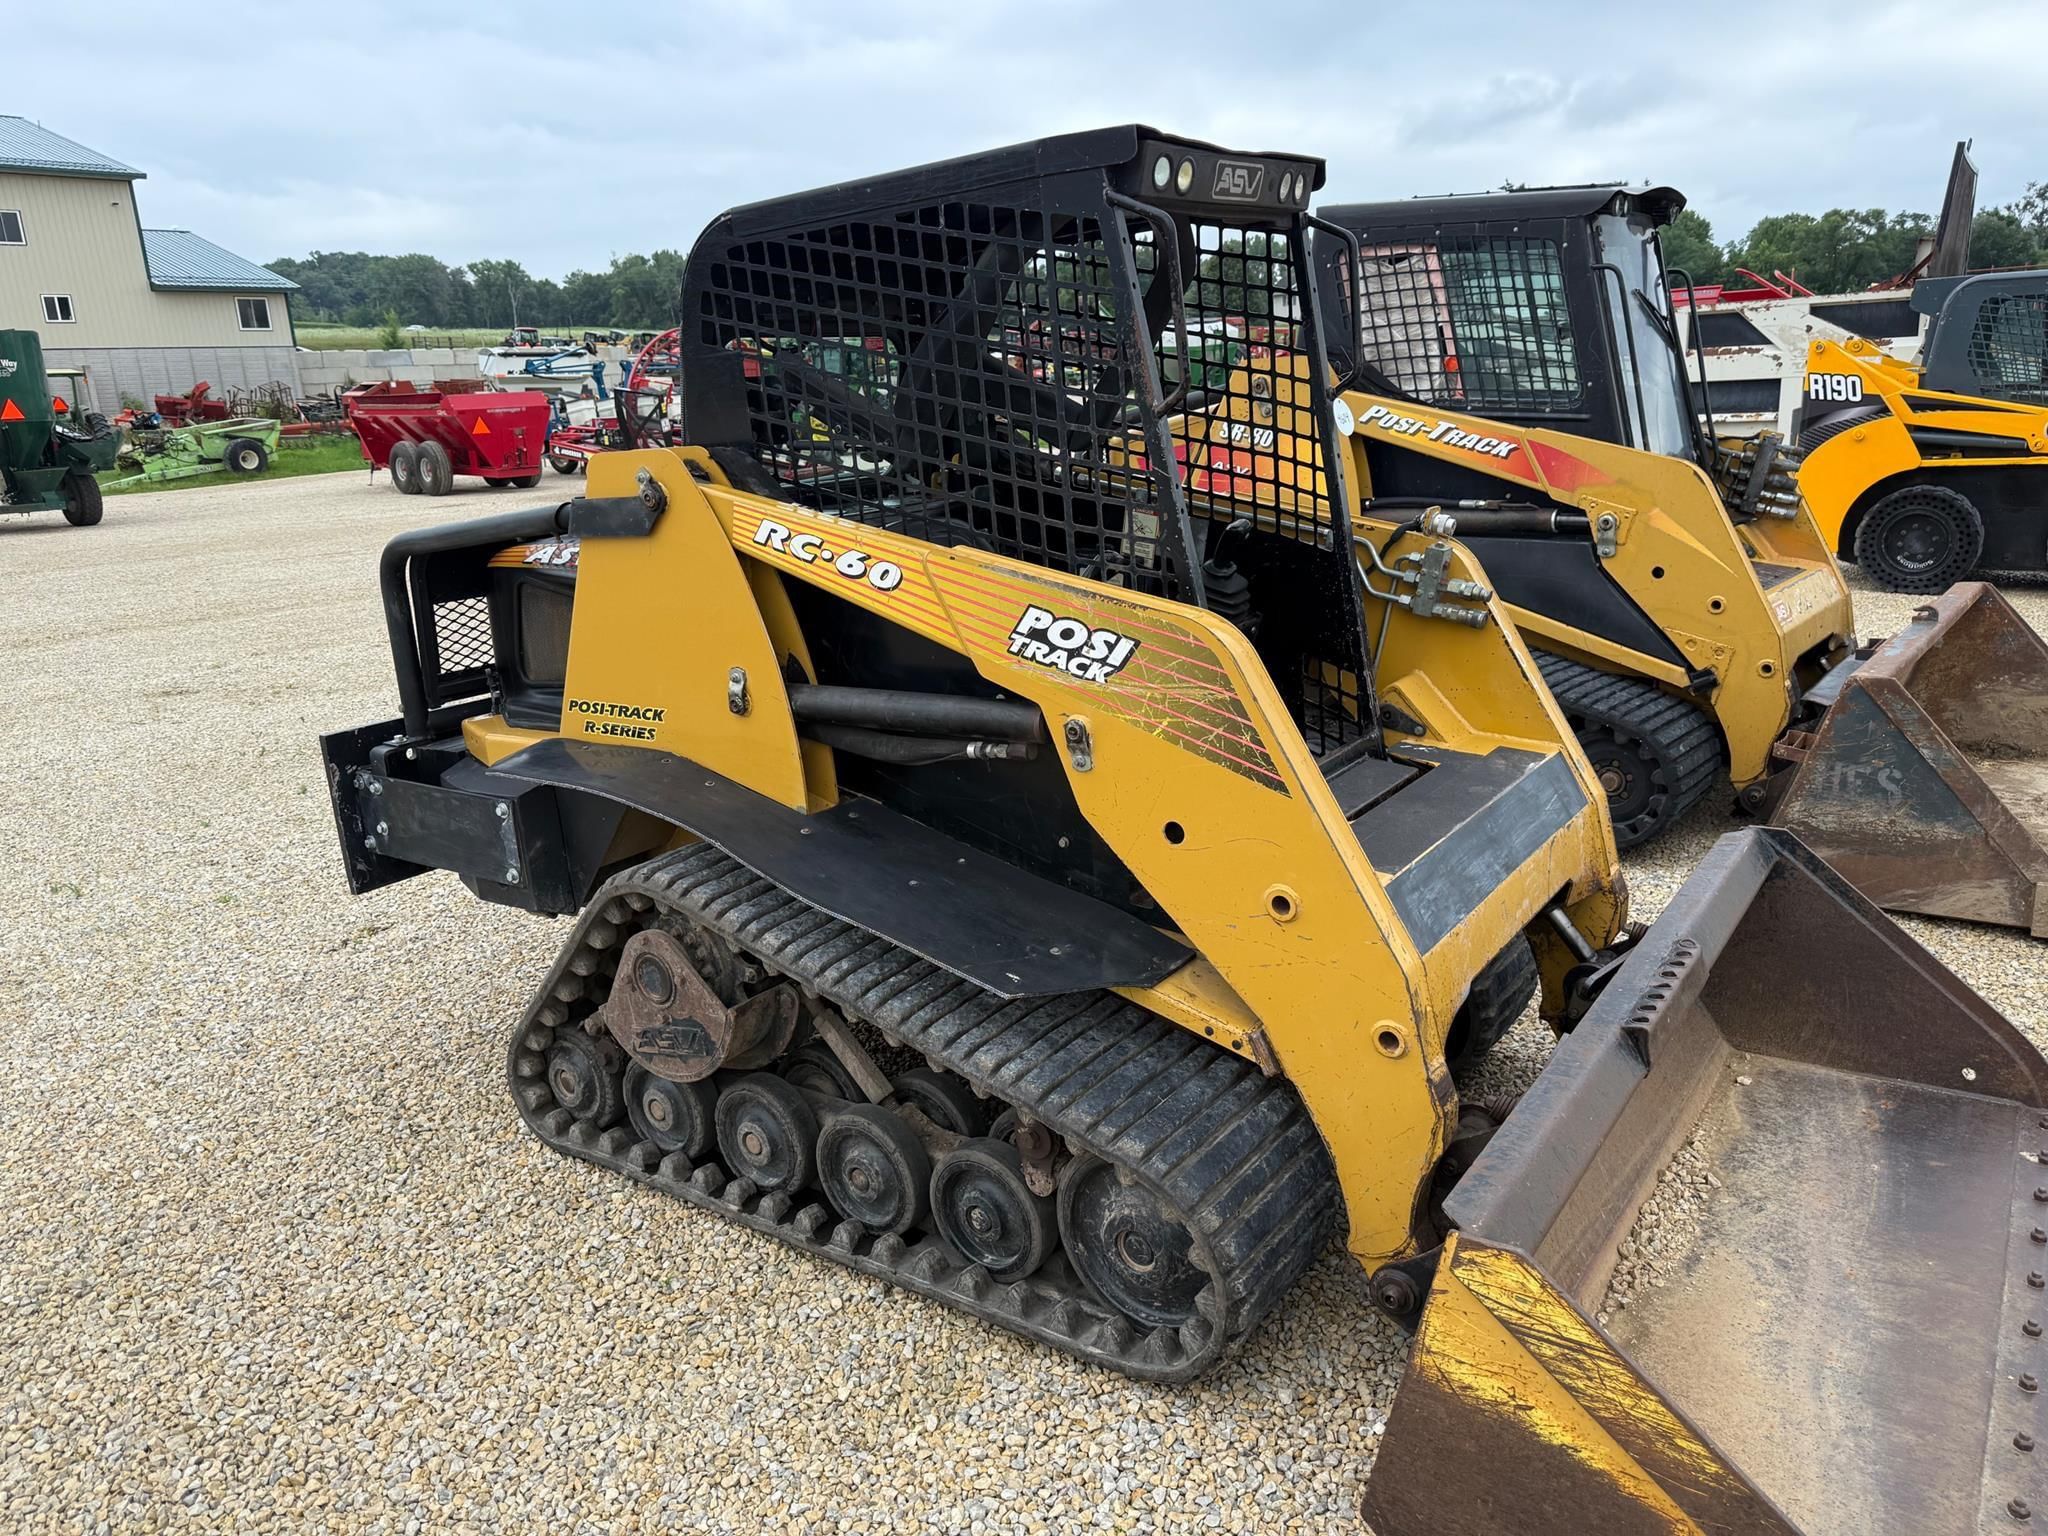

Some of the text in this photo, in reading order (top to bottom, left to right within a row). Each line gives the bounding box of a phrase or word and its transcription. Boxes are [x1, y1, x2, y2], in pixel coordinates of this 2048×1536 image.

[1216, 167, 1261, 194] ASV
[1808, 373, 1862, 402] R190
[1359, 405, 1520, 459] POSI-TRACK
[522, 546, 580, 566] AS
[1014, 605, 1138, 668] POSI
[1008, 633, 1116, 684] TRACK
[568, 699, 666, 722] POSI-TRACK
[584, 720, 656, 741] R-SERIES
